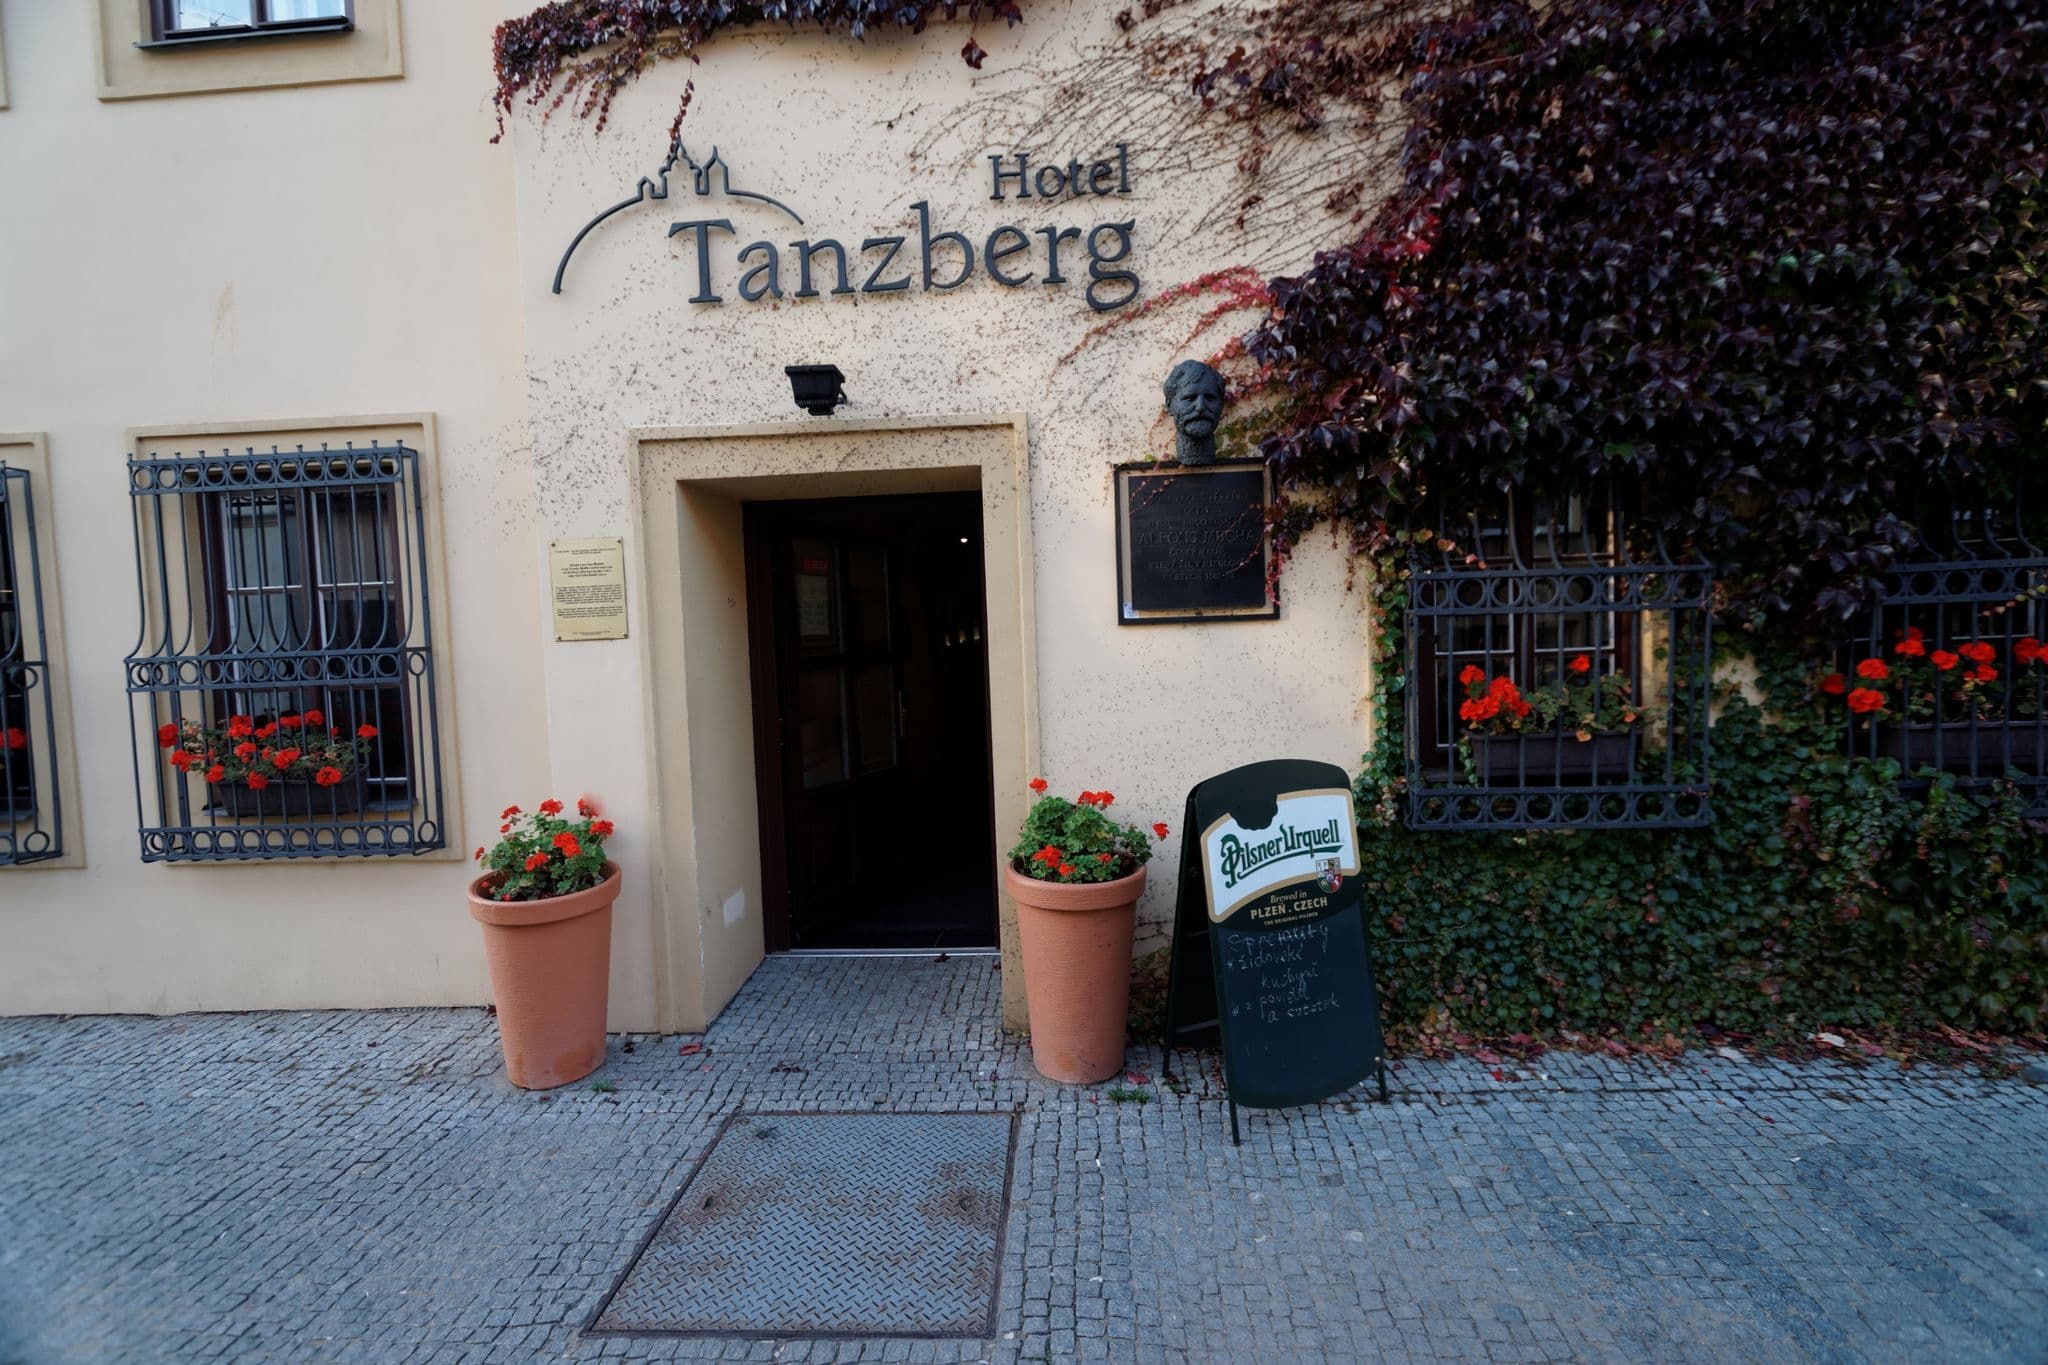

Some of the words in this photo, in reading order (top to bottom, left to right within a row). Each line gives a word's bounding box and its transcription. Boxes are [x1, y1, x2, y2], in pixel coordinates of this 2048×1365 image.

[988, 143, 1133, 201] Hotel
[668, 201, 1140, 311] Tanzberg
[1220, 834, 1283, 889] Pilsner
[1279, 819, 1340, 859] Urquell
[1270, 891, 1298, 904] Brewed
[1299, 890, 1308, 899] in
[1293, 897, 1329, 913] CZECH
